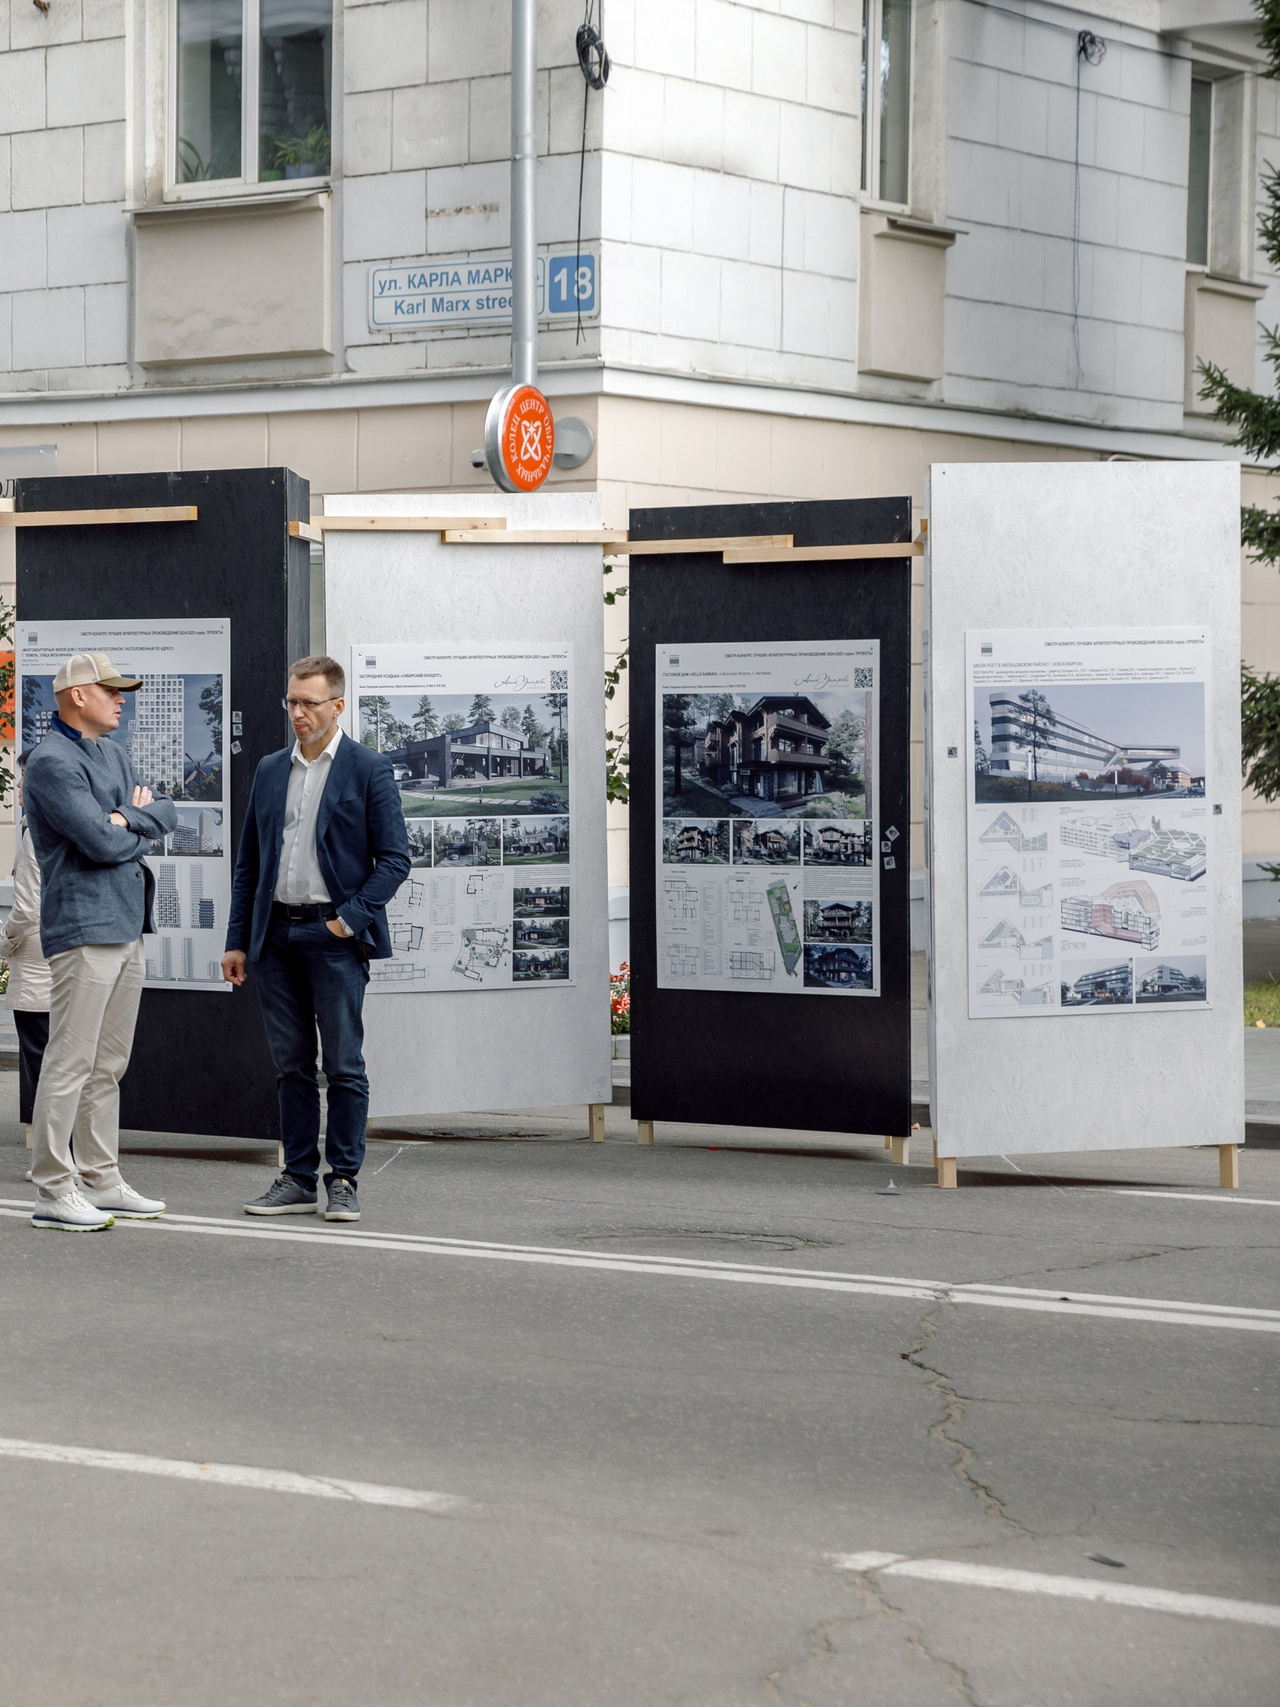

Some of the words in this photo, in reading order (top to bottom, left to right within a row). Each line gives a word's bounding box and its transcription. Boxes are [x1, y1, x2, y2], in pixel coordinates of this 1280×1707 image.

[378, 278, 402, 295] ул.
[407, 271, 462, 289] КАРЛА
[467, 266, 515, 287] МАРК
[553, 266, 594, 302] 18
[394, 298, 425, 316] Karl
[431, 296, 471, 314] Marx
[476, 293, 514, 311] stree
[519, 398, 545, 415] ЦЕНТР
[509, 413, 522, 464] КОЛЕЦ
[515, 414, 554, 483] ОБРУЧАЛЬНЫХ
